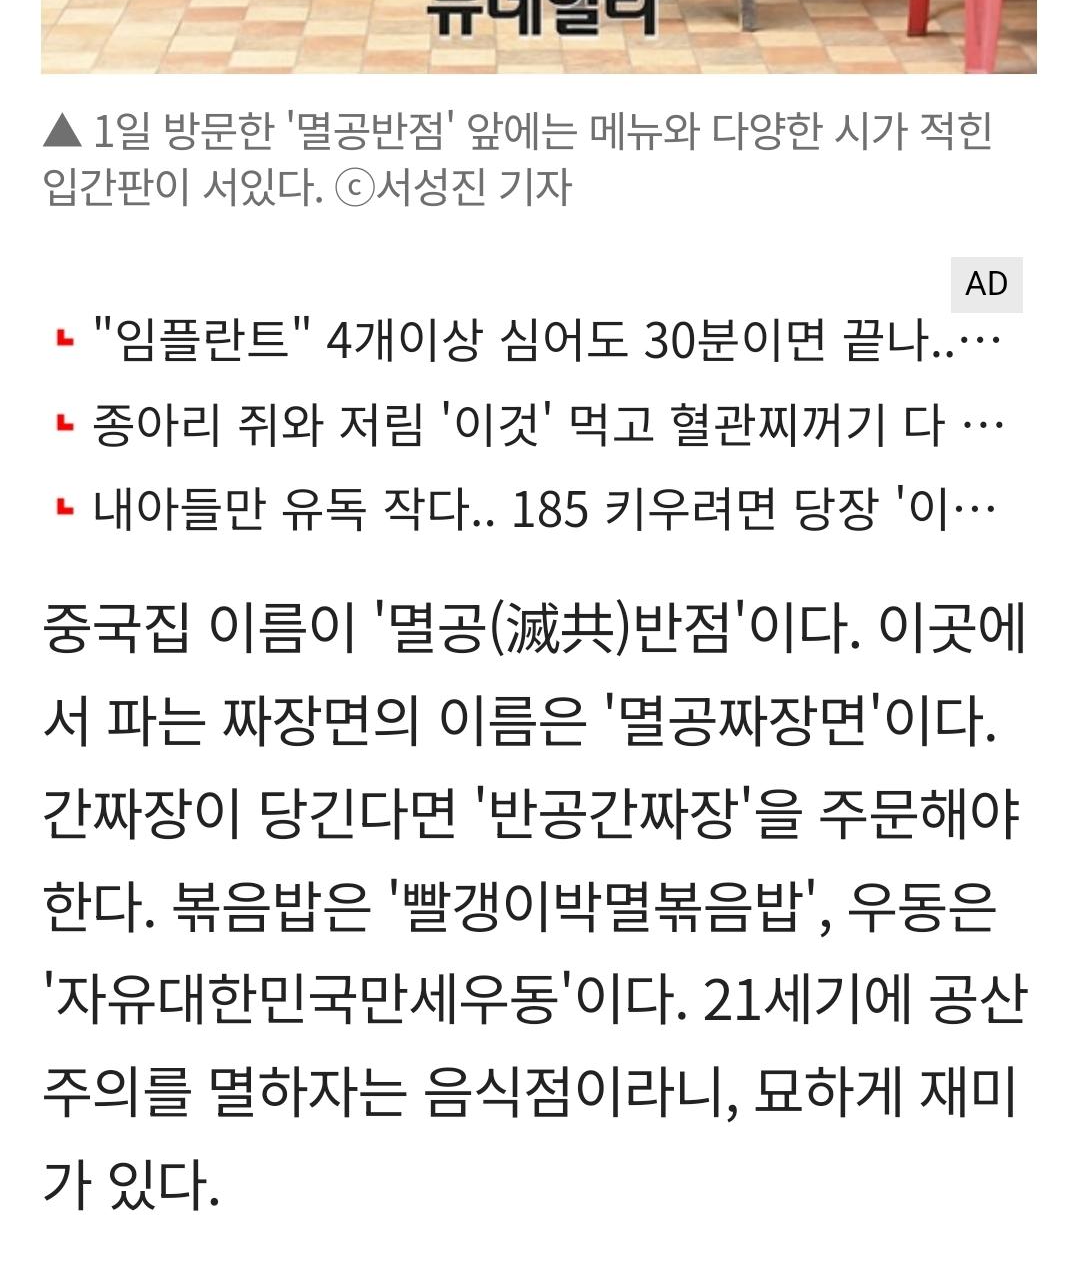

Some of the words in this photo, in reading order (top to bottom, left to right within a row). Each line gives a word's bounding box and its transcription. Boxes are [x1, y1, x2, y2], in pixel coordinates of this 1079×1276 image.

[96, 112, 149, 150] 1일
[166, 112, 275, 150] 방문한
[288, 110, 453, 150] '멸공반점'
[468, 112, 577, 150] 앞에는
[591, 112, 700, 150] 메뉴와
[714, 112, 823, 151] 다양한
[835, 112, 908, 151] 시가
[921, 112, 991, 150] 적힌
[44, 168, 187, 206] 입간판이
[204, 168, 322, 207] 서있다.
[500, 168, 572, 206] 기자
[965, 271, 1007, 295] AD
[96, 316, 309, 361] "임플란트"
[327, 318, 483, 362] 4개이상
[501, 318, 628, 362] 심어도
[645, 318, 823, 362] 30분이면
[94, 403, 218, 447] 종아리
[239, 403, 324, 447] 쥐와
[340, 403, 421, 447] 저림
[444, 401, 550, 447] '이것'
[571, 403, 653, 447] 먹고
[671, 403, 883, 447] 혈관찌꺼기
[906, 403, 945, 447] 다
[95, 487, 266, 531] 내아들만
[283, 489, 366, 532] 유독
[385, 487, 493, 531] 작다..
[514, 490, 587, 528] 185
[607, 487, 774, 531] 키우려면
[796, 487, 879, 531] 당장
[44, 602, 187, 654] 중국집
[211, 602, 352, 653] 이름이
[377, 599, 859, 656] '멸공(滅共)반점'이다.
[880, 602, 1023, 654] 이곳에
[44, 695, 86, 747] 서
[108, 695, 205, 747] 파는
[223, 695, 416, 747] 짜장면의
[441, 695, 586, 747] 이름은
[607, 692, 995, 747] '멸공짜장면'이다.
[44, 788, 237, 840] 간짜장이
[262, 788, 454, 840] 당긴다면
[478, 785, 802, 840] '반공간짜장'을
[820, 788, 1019, 840] 주문해야
[44, 881, 154, 933] 한다.
[173, 881, 371, 932] 볶음밥은
[391, 878, 830, 937] '빨갱이박멸볶음밥',
[849, 883, 996, 933] 우동은
[46, 970, 686, 1025] '자유대한민국만세우동'이다.
[705, 973, 909, 1024] 21세기에
[930, 973, 1028, 1024] 공산
[44, 1066, 191, 1118] 주의를
[211, 1066, 407, 1118] 멸하자는
[425, 1066, 737, 1122] 음식점이라니,
[755, 1066, 900, 1118] 묘하게
[921, 1066, 1013, 1118] 재미
[44, 1159, 92, 1211] 가
[110, 1159, 218, 1211] 있다.
